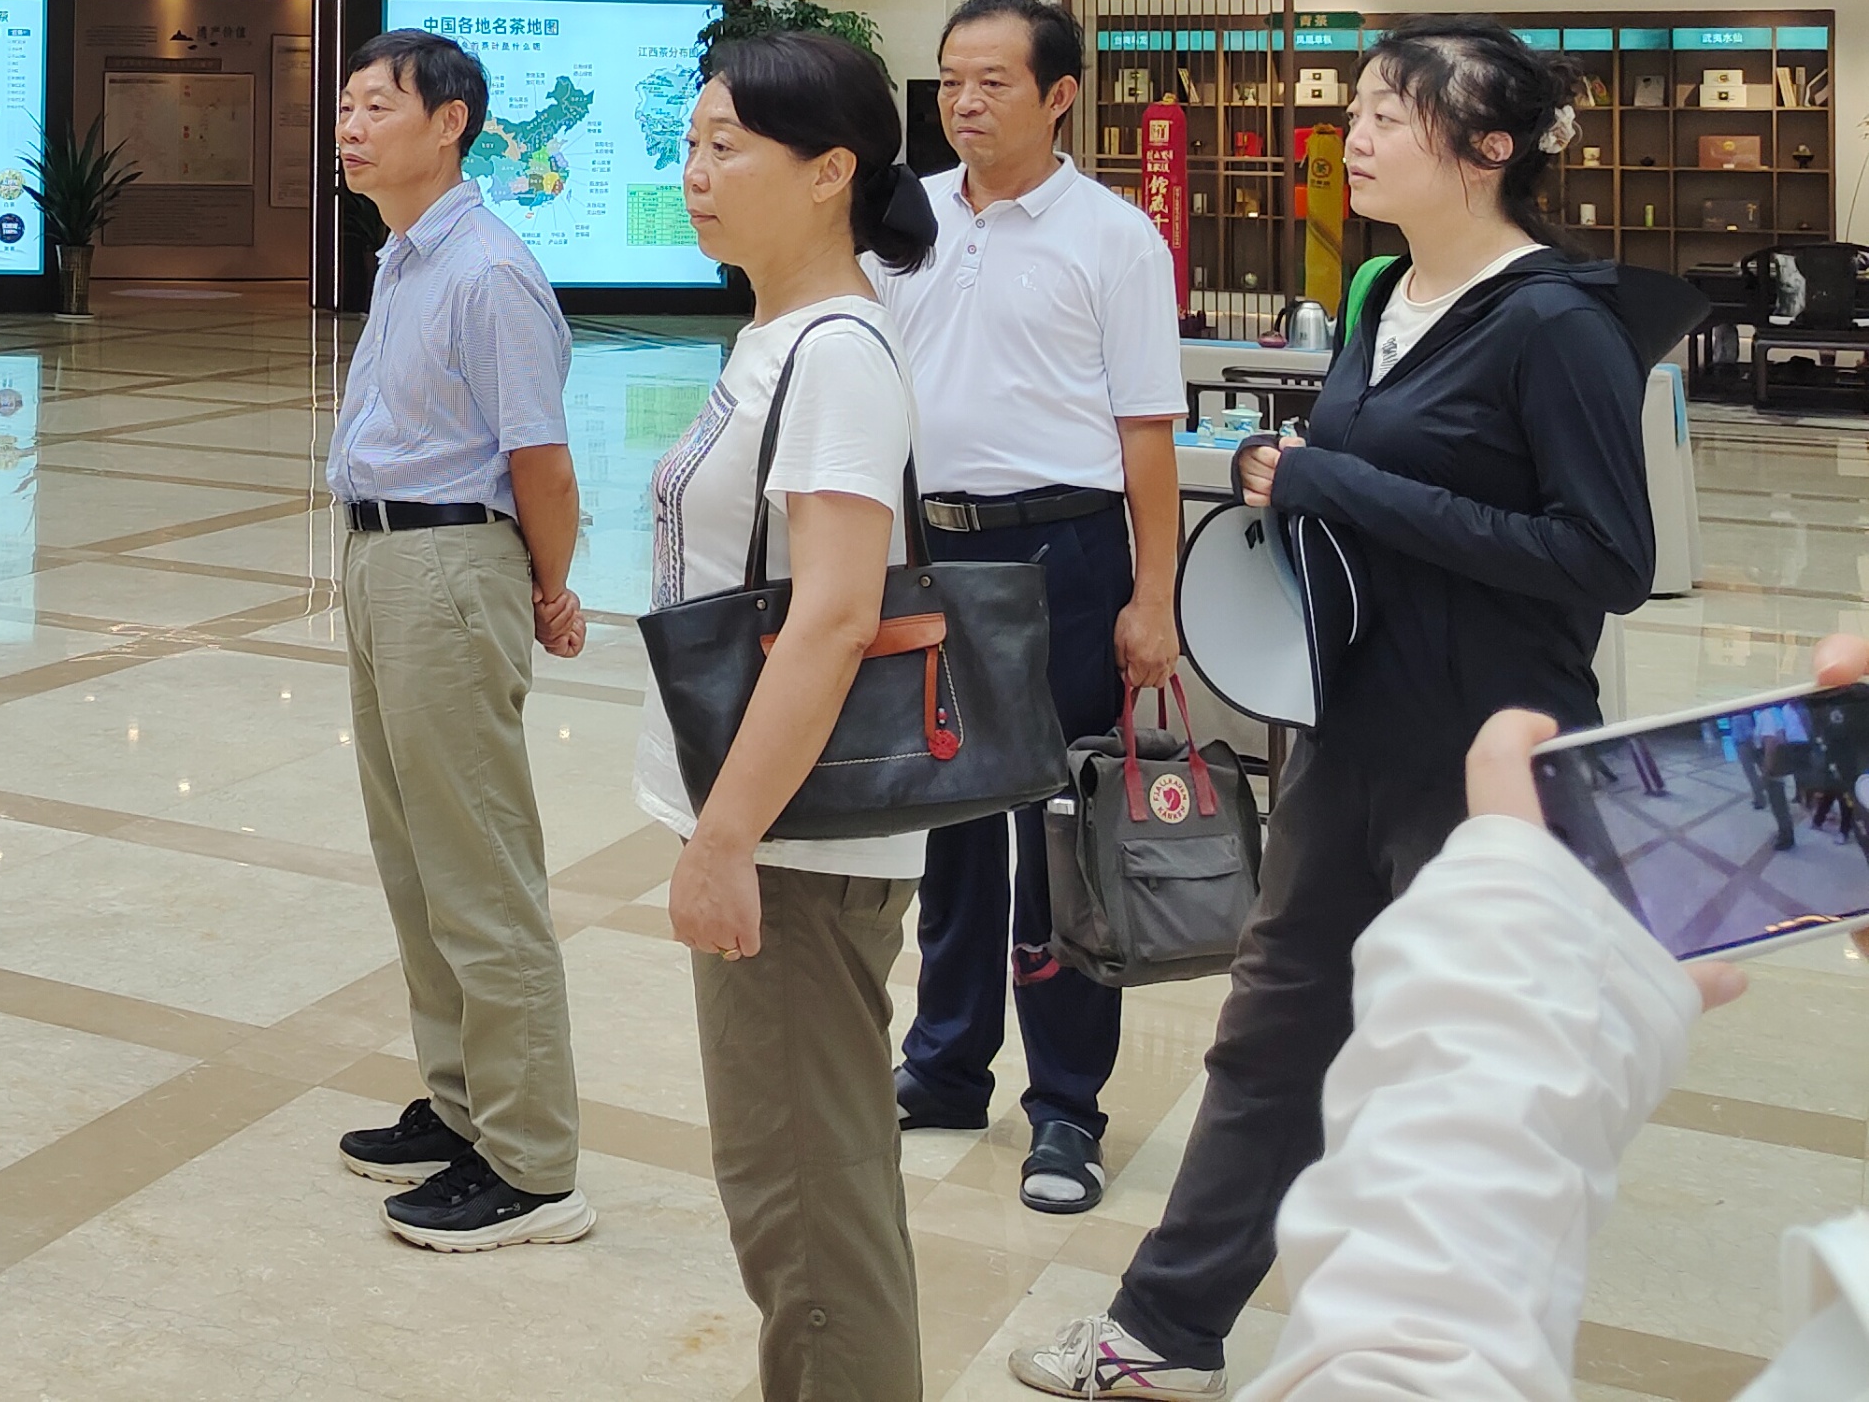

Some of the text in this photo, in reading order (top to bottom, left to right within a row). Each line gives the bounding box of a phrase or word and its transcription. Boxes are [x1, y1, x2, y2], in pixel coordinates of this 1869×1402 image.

[423, 16, 560, 37] 中国各地名茶地图
